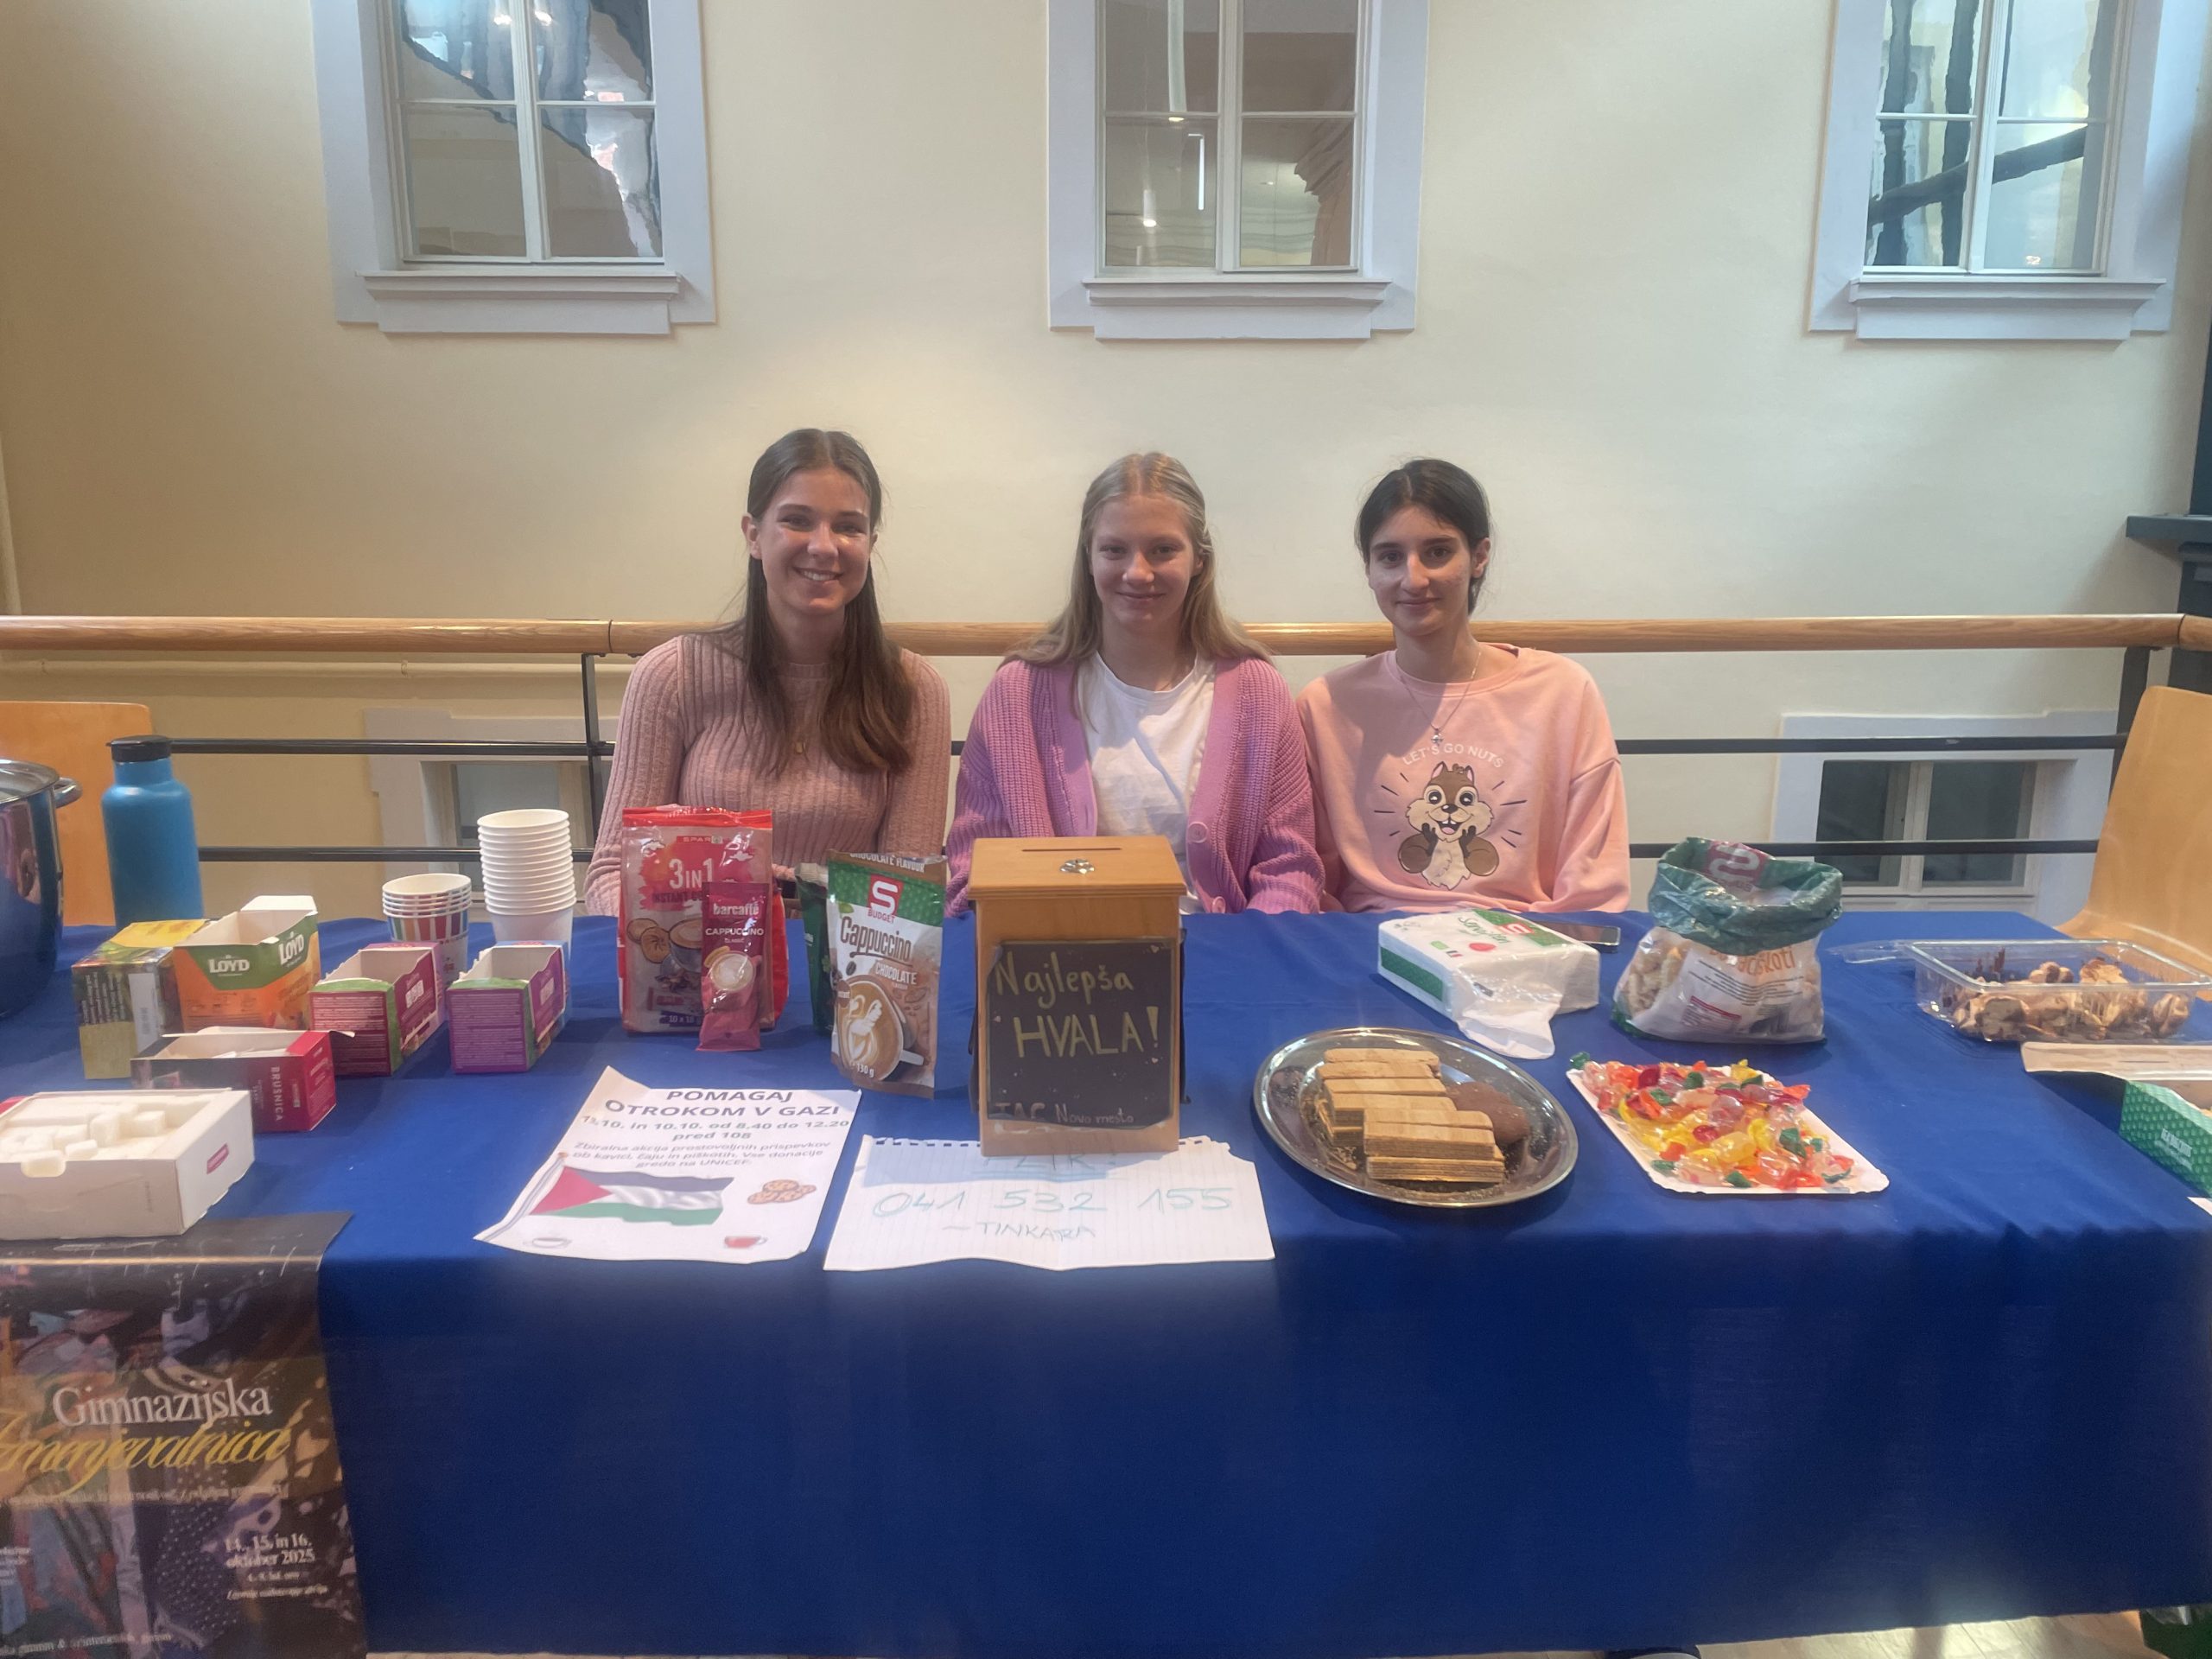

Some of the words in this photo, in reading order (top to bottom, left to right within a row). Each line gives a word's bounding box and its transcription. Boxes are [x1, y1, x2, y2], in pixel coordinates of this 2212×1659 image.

[1402, 744, 1440, 766] LET'S
[1444, 743, 1465, 754] GO
[1468, 746, 1503, 768] NUTS
[868, 908, 895, 924] BUDGET
[840, 915, 912, 962] Cappuccino
[279, 933, 305, 966] LOYD
[208, 957, 251, 974] LOYD
[875, 962, 917, 985] CHOCOLATE
[994, 950, 1135, 1009] Najlepša
[1013, 1006, 1160, 1058] HVALA!
[856, 1063, 868, 1075] 130
[270, 1065, 284, 1122] BRUSNICA
[666, 1090, 793, 1103] POMAGAJ
[605, 1099, 746, 1116] OTROKOM
[755, 1106, 772, 1116] V
[779, 1105, 840, 1116] GAZI
[1055, 1103, 1092, 1125] Novo
[1095, 1107, 1135, 1124] mesto
[631, 1121, 647, 1130] in
[804, 1120, 850, 1128] 12.20
[671, 1132, 716, 1141] pred
[574, 1141, 629, 1151] Zbiralna
[631, 1142, 669, 1152] akcija
[671, 1142, 757, 1153] prostovoljnih
[760, 1141, 831, 1152] prispevkov
[769, 1149, 823, 1159] donacije
[872, 1190, 966, 1217] 041
[995, 1188, 1109, 1212] 532
[1136, 1187, 1234, 1214] 155
[980, 1221, 1096, 1243] TINKARA
[52, 1377, 273, 1429] Gimnazijska
[275, 1533, 289, 1548] in
[281, 1548, 316, 1566] 2025
